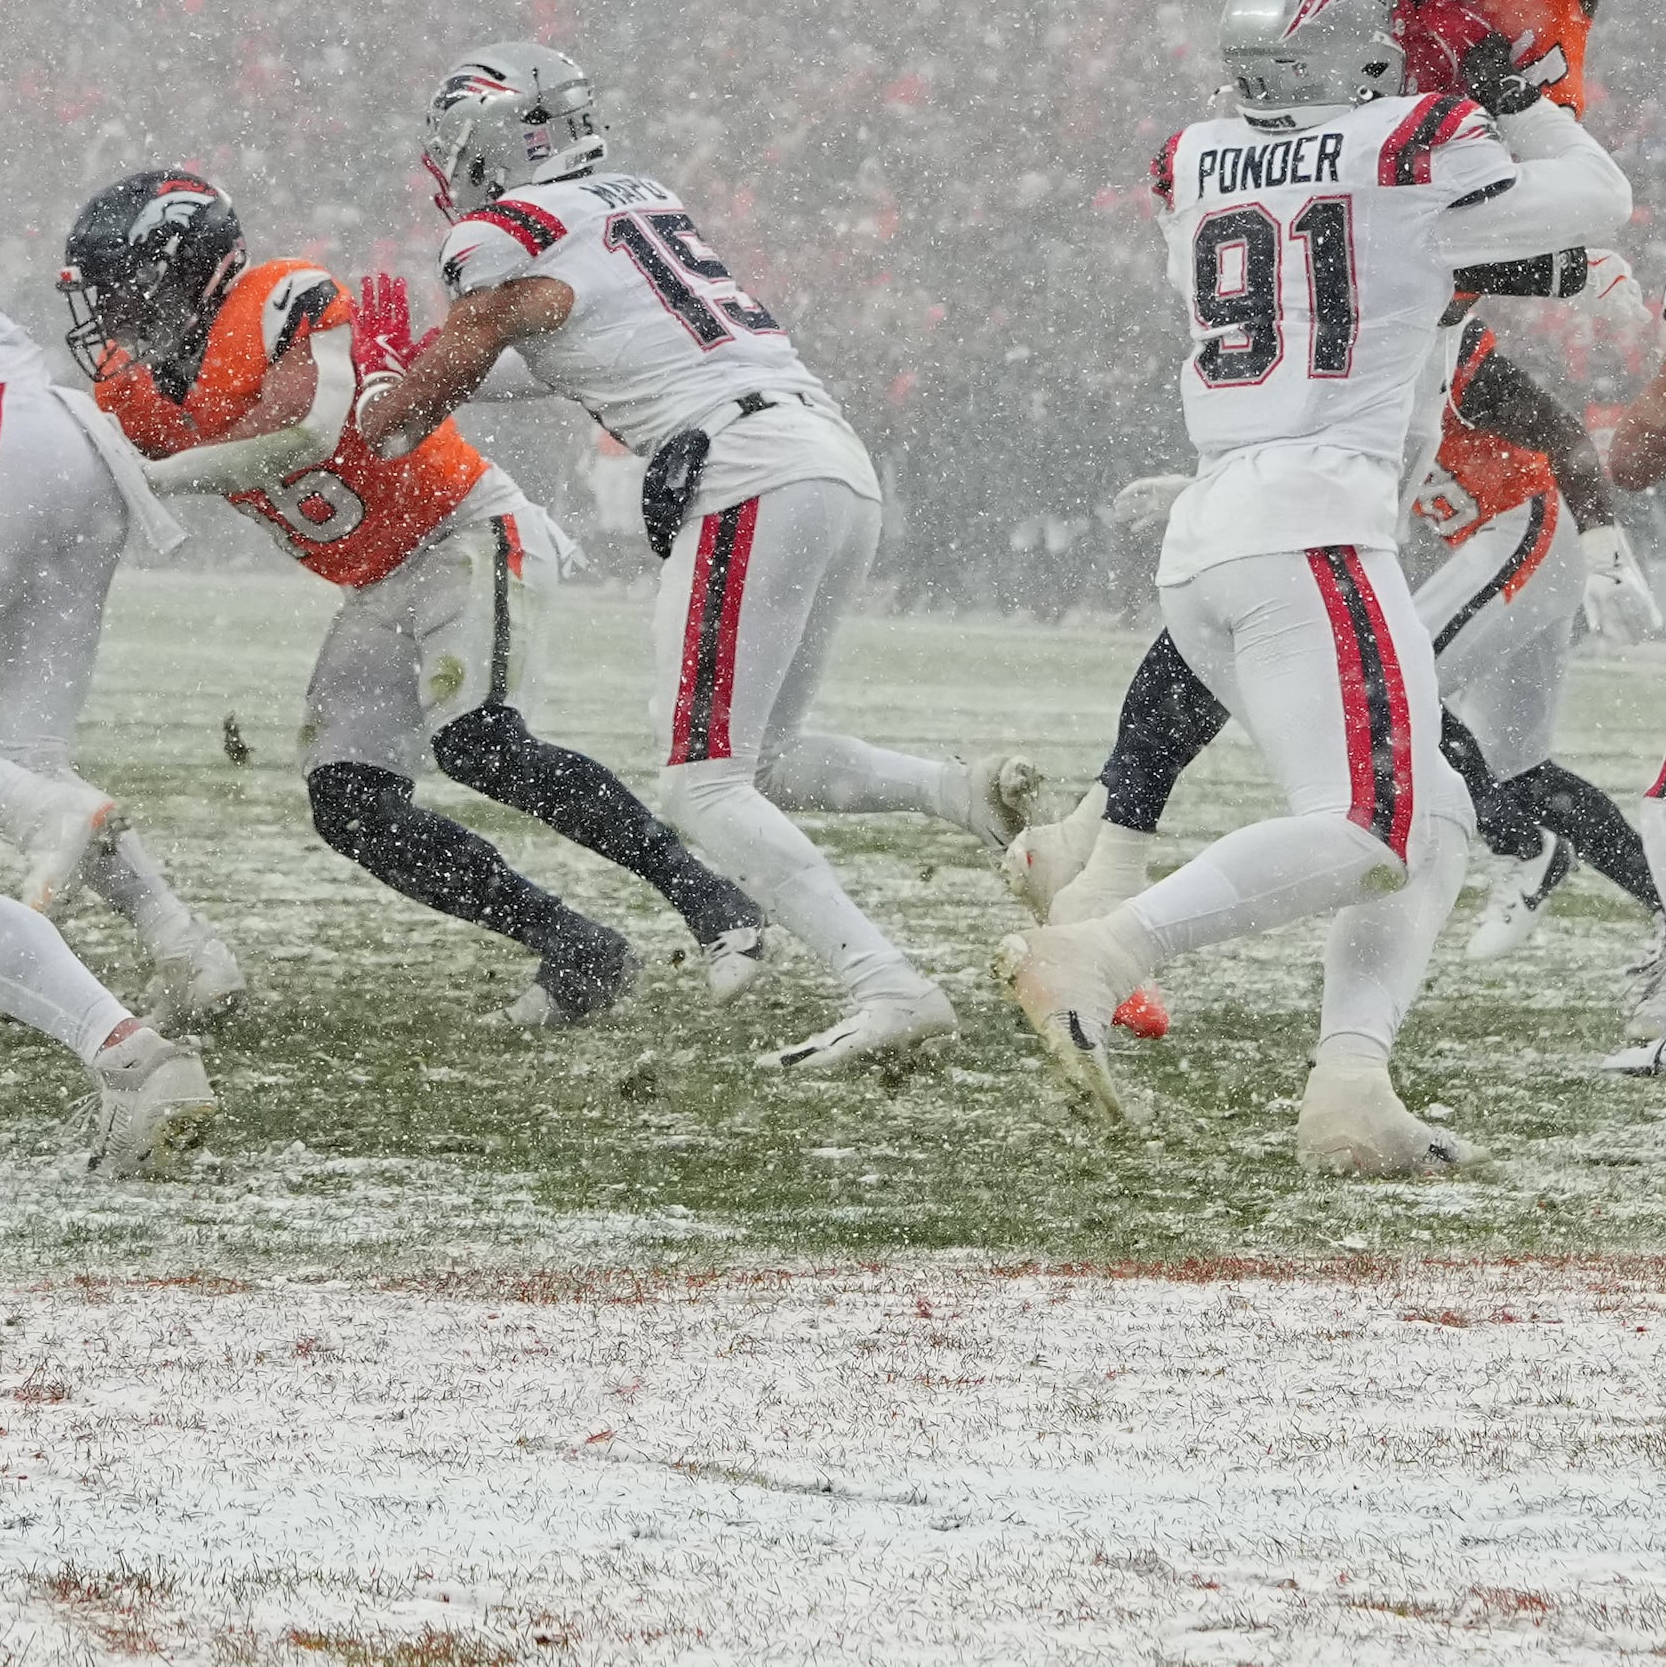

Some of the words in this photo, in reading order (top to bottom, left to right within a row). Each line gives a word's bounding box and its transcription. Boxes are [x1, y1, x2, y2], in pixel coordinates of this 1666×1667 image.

[1197, 133, 1344, 201] PONDER
[603, 208, 788, 353] 15
[1193, 193, 1360, 389] 91
